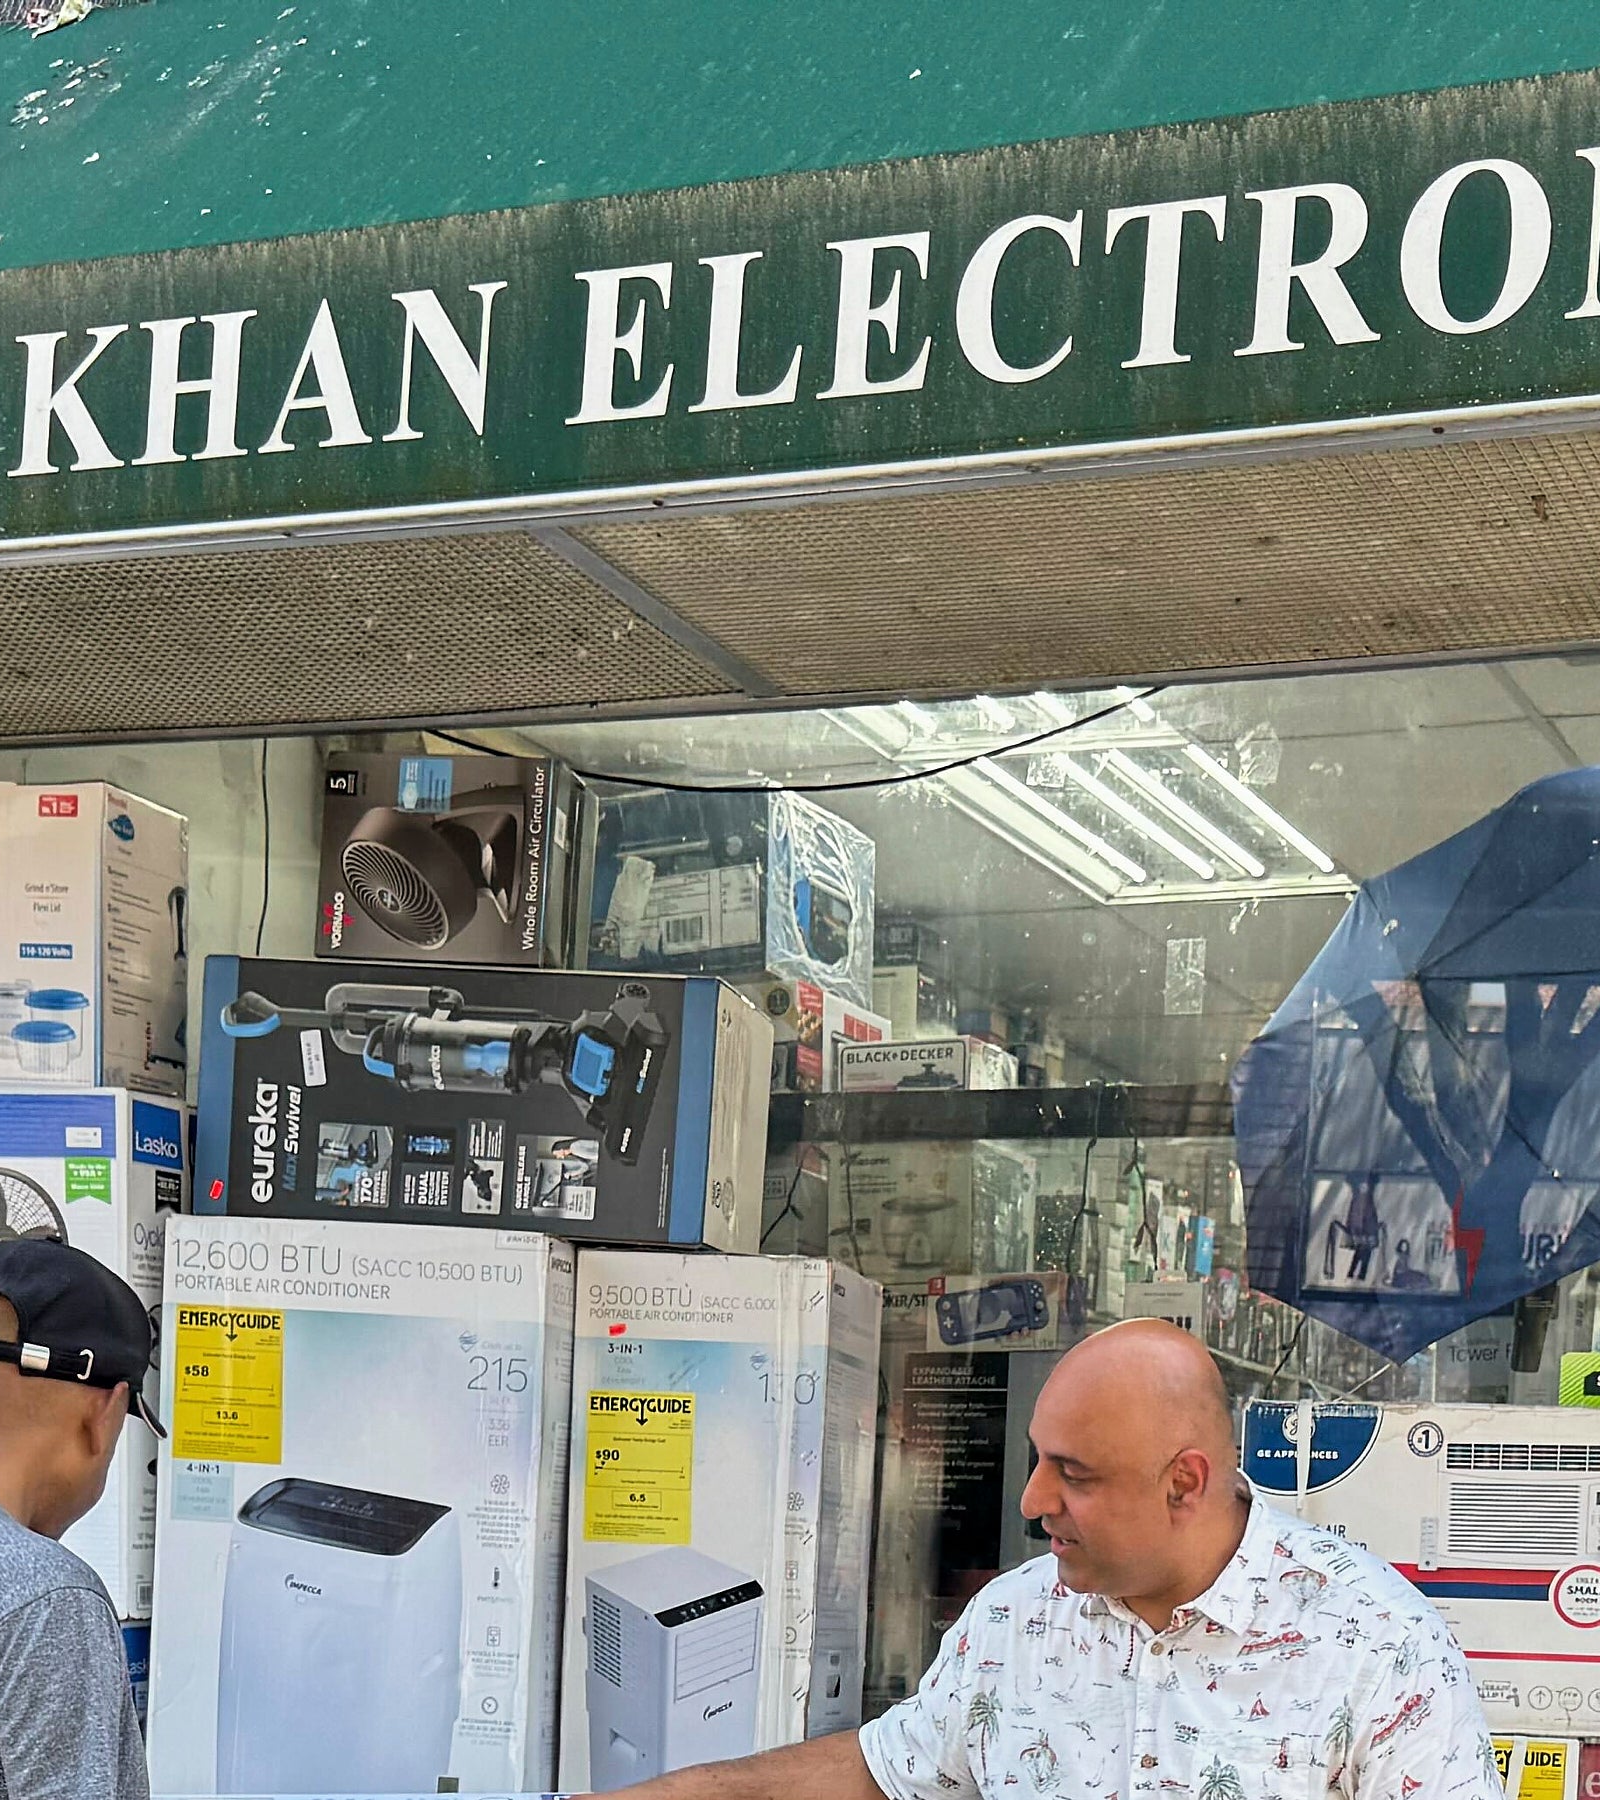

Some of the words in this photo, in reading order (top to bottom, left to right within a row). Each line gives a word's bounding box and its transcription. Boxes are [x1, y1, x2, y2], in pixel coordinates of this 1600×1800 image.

[6, 281, 508, 477] KHAN
[531, 765, 545, 825] Circulator
[330, 891, 345, 949] VORNADO
[134, 1129, 179, 1159] Lasko
[248, 1080, 279, 1203] eureka
[172, 1238, 269, 1274] 12,600
[280, 1244, 341, 1277] BTU
[351, 1255, 412, 1280] (SACC
[417, 1260, 475, 1285] 10,500
[480, 1263, 523, 1286] BTU)
[174, 1273, 253, 1293] PORTABLE
[255, 1276, 280, 1294] AIR
[283, 1279, 391, 1300] CONDITIONER
[589, 1284, 648, 1308] 9,500
[652, 1285, 692, 1308] BTU
[179, 1309, 281, 1331] ENERGYGUIDE
[589, 1307, 637, 1322] PORTABLE
[640, 1309, 660, 1322] AIR
[662, 1309, 734, 1324] CONDITIONER
[607, 1342, 643, 1355] 3-IN-1
[183, 1364, 210, 1378] $58
[467, 1355, 528, 1393] 215
[589, 1395, 692, 1415] ENERGYGUIDE
